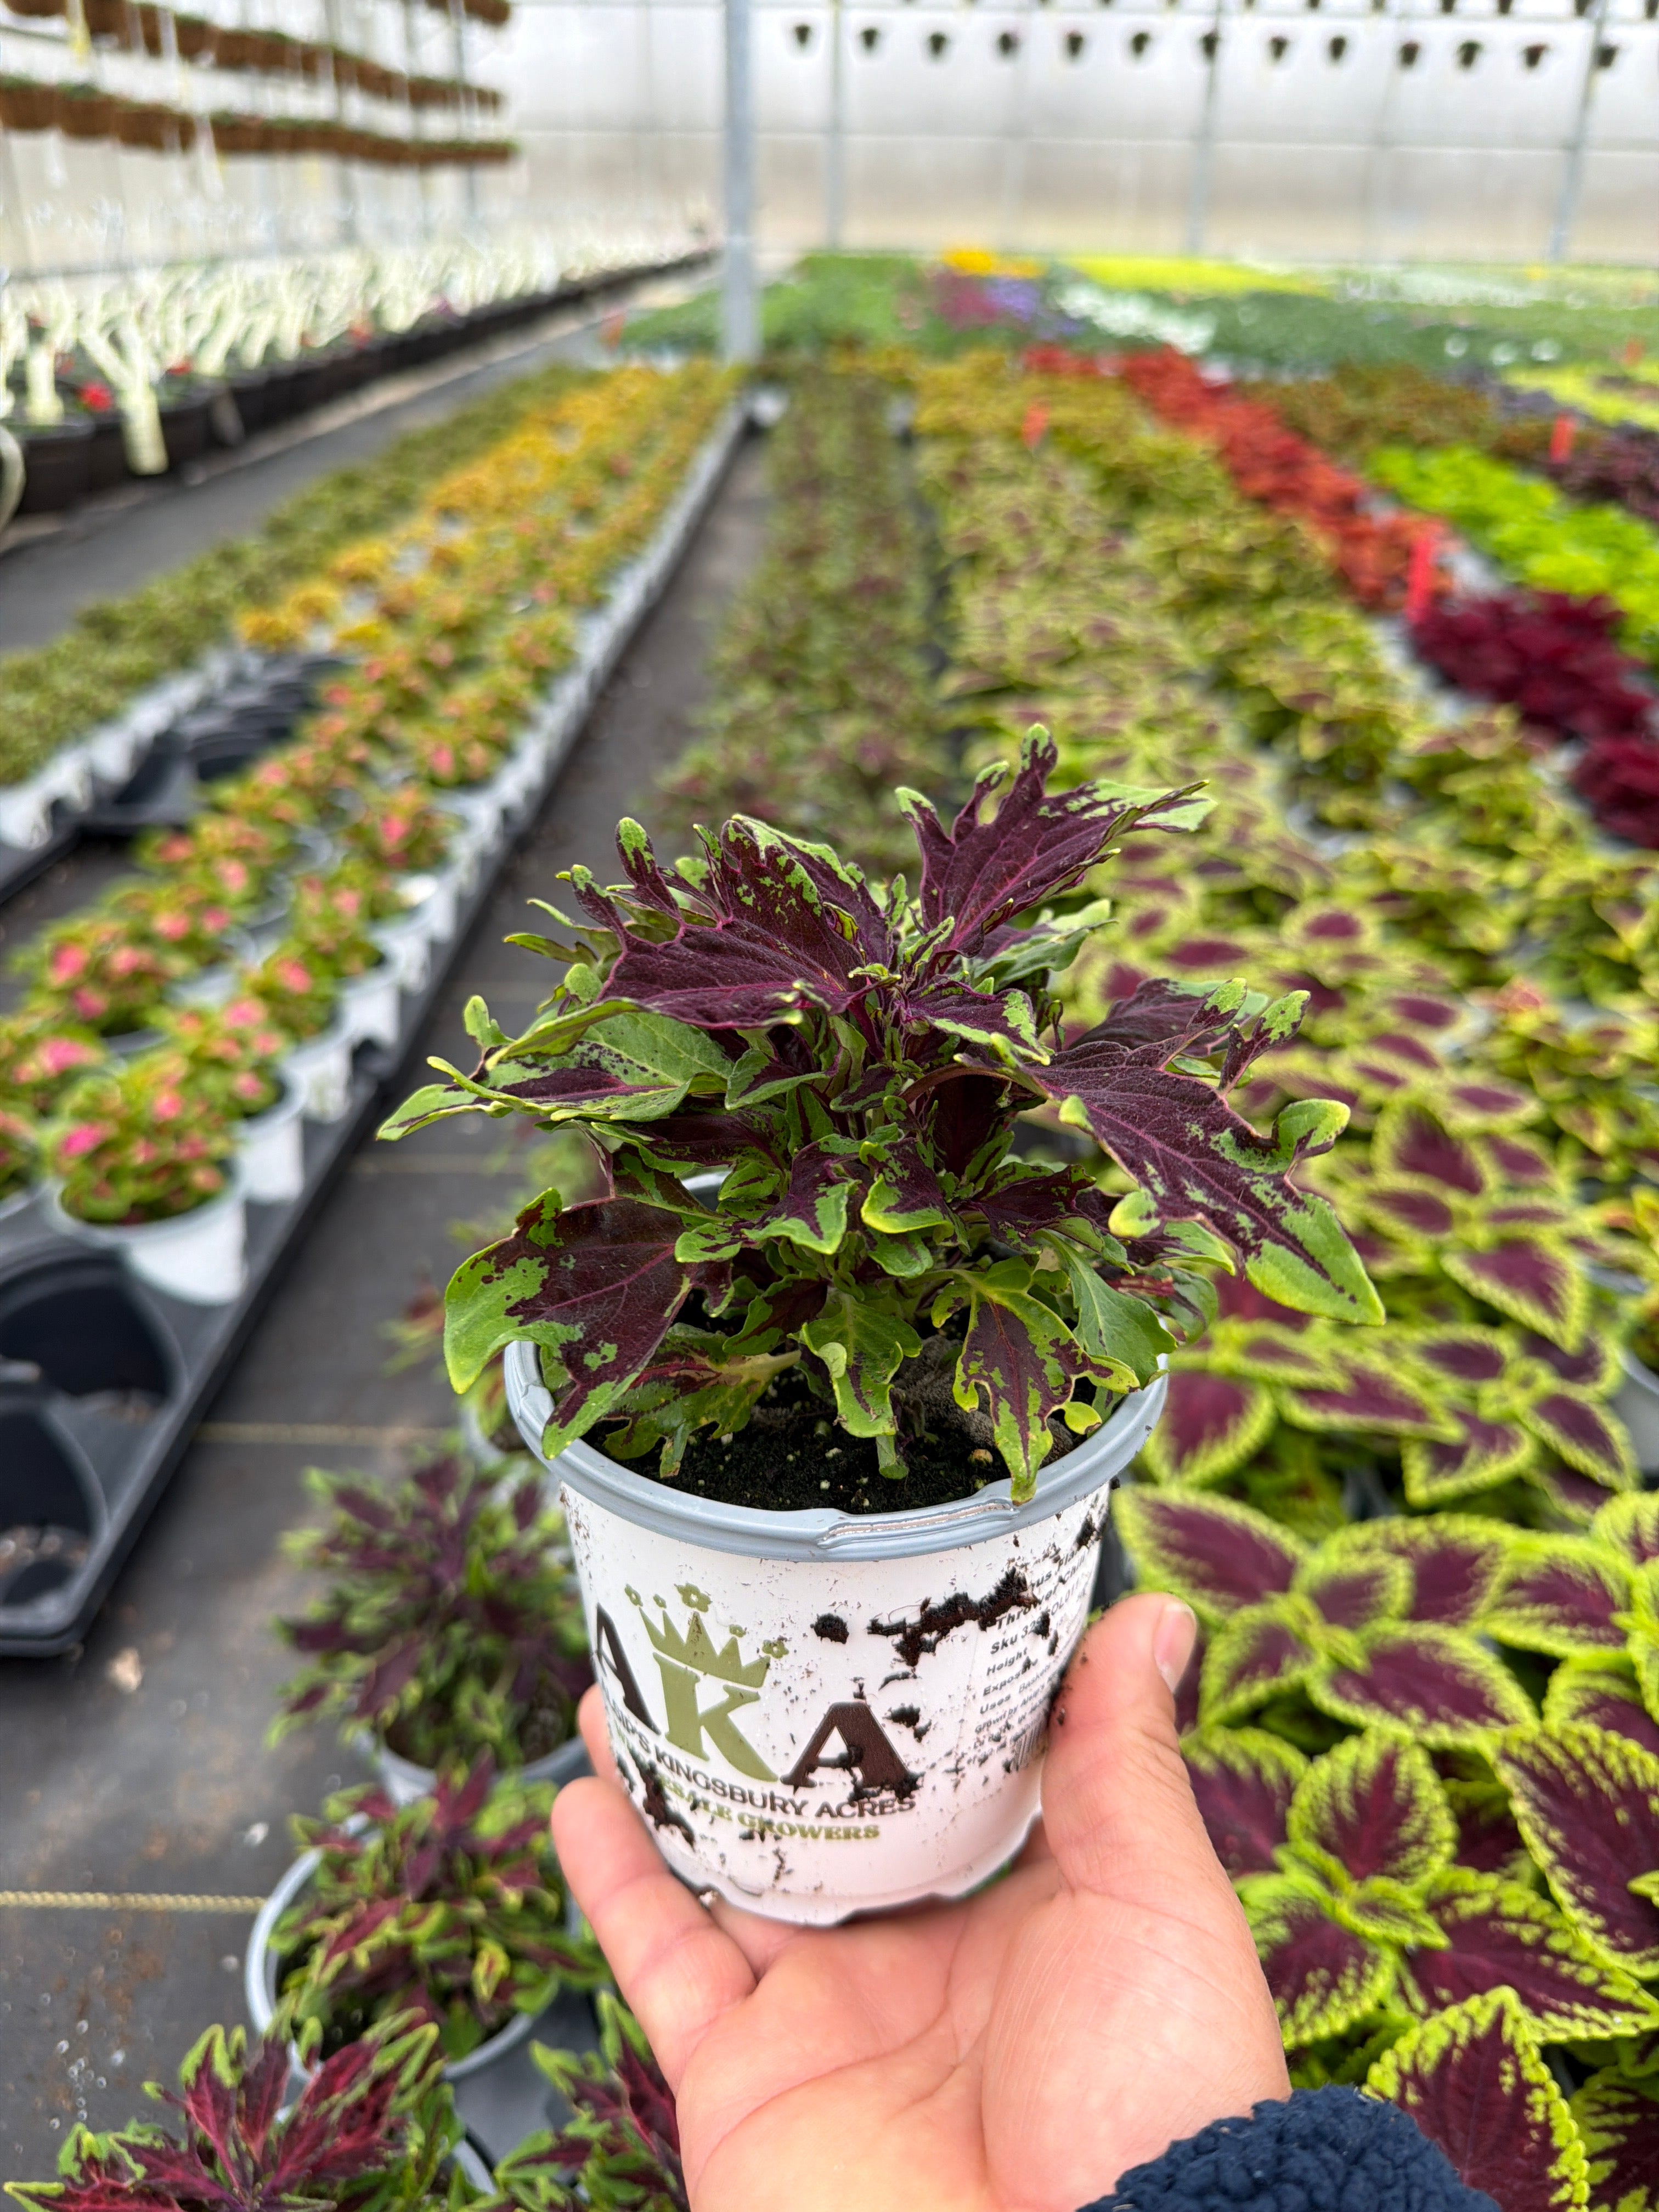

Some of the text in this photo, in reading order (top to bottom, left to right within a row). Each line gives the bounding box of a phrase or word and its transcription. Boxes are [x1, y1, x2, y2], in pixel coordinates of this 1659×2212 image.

[991, 1634, 1018, 1655] Sku
[986, 1647, 1028, 1675] Height
[980, 1694, 1011, 1714] Uses
[655, 1743, 809, 1816] KINGSBURY
[815, 1797, 916, 1818] ACRES
[737, 1812, 880, 1840] GROWERS
